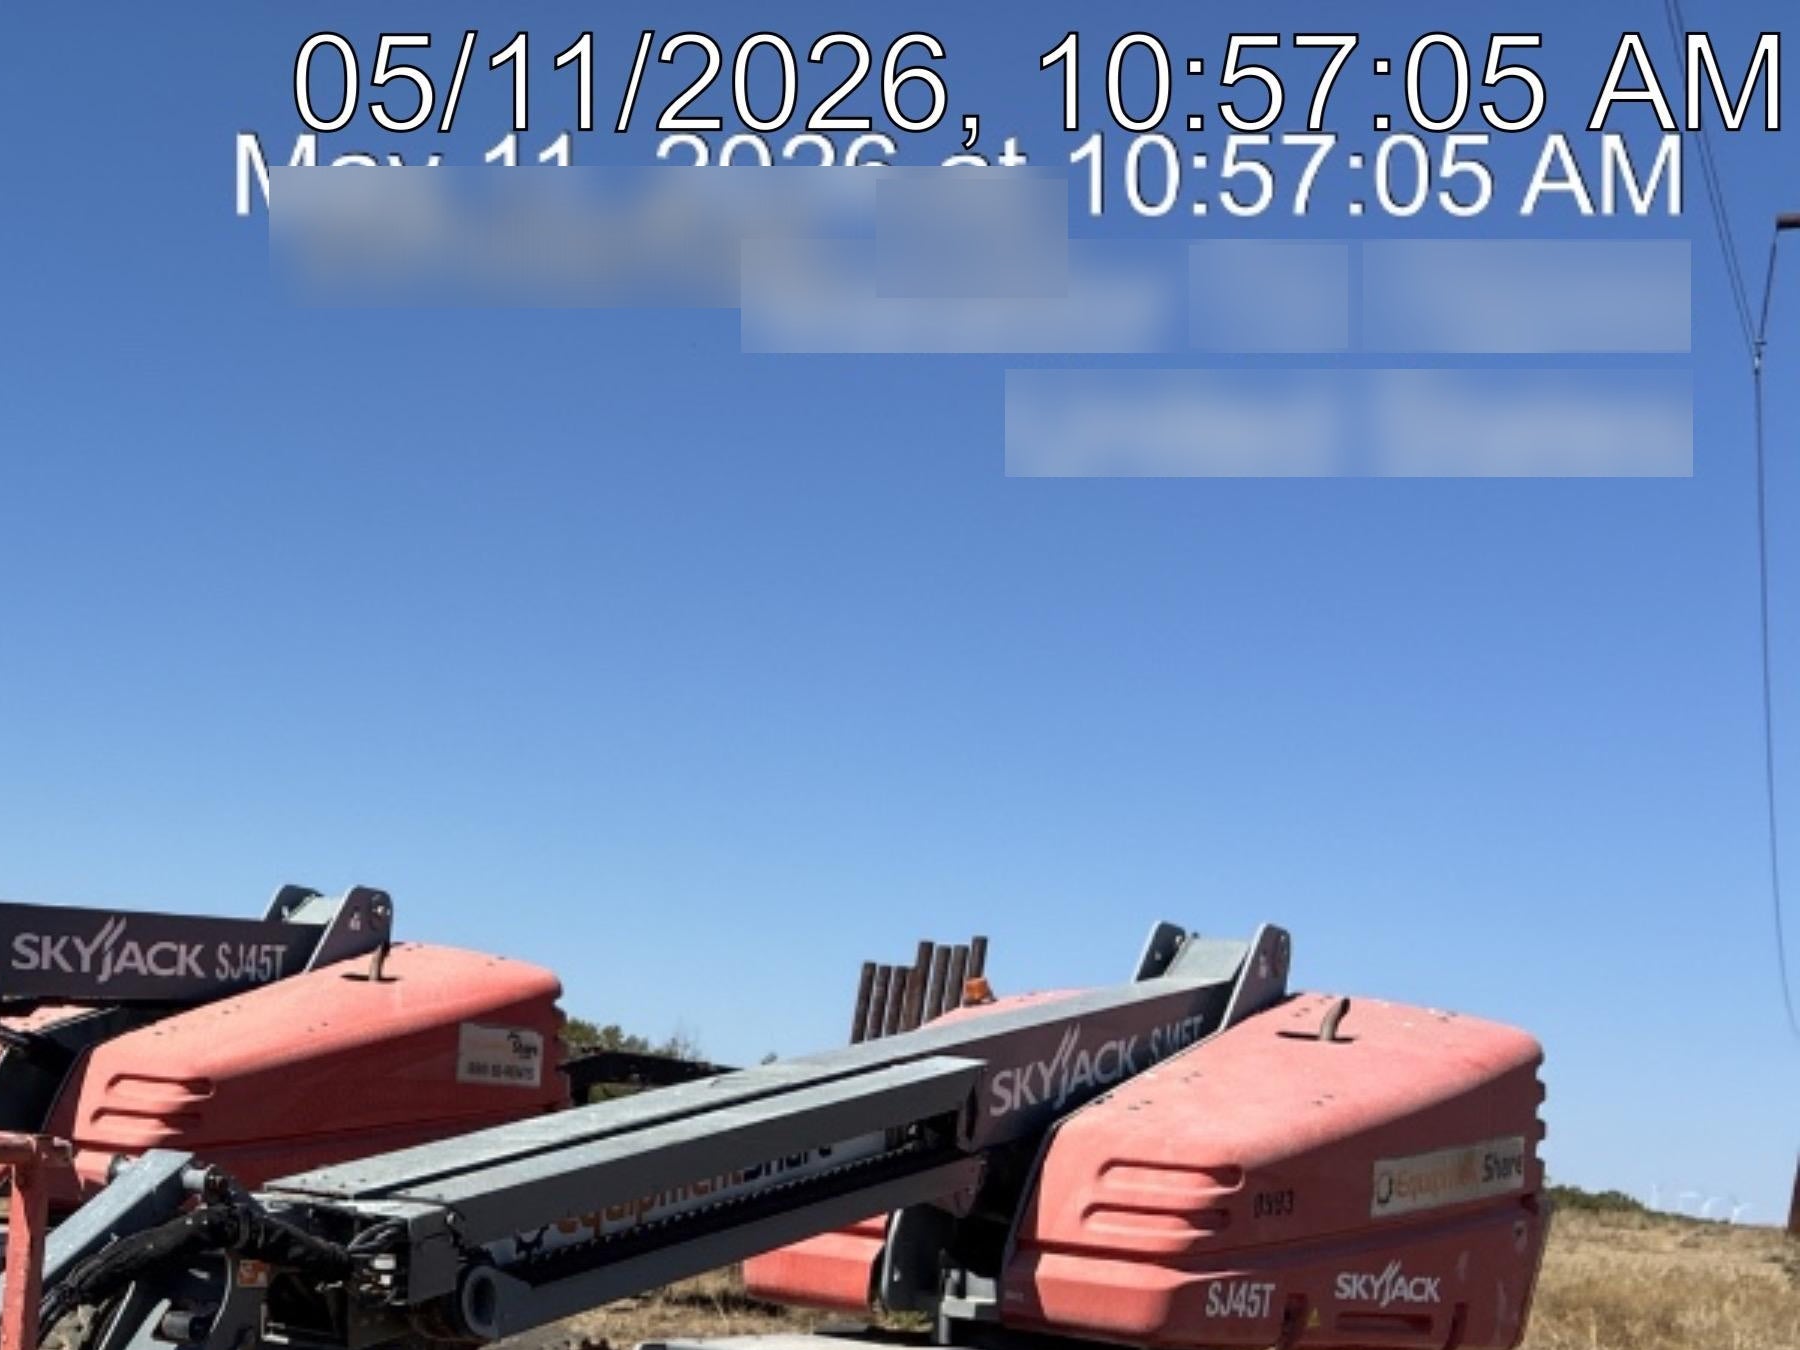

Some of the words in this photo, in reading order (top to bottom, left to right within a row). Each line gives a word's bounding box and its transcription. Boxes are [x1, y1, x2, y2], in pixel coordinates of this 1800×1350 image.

[11, 915, 206, 984] SKYJACK
[216, 942, 288, 983] SJ45T
[989, 1022, 1138, 1117] SKYJACK
[1205, 1280, 1276, 1318] SJ45T
[1335, 1259, 1442, 1309] SKYJACK
